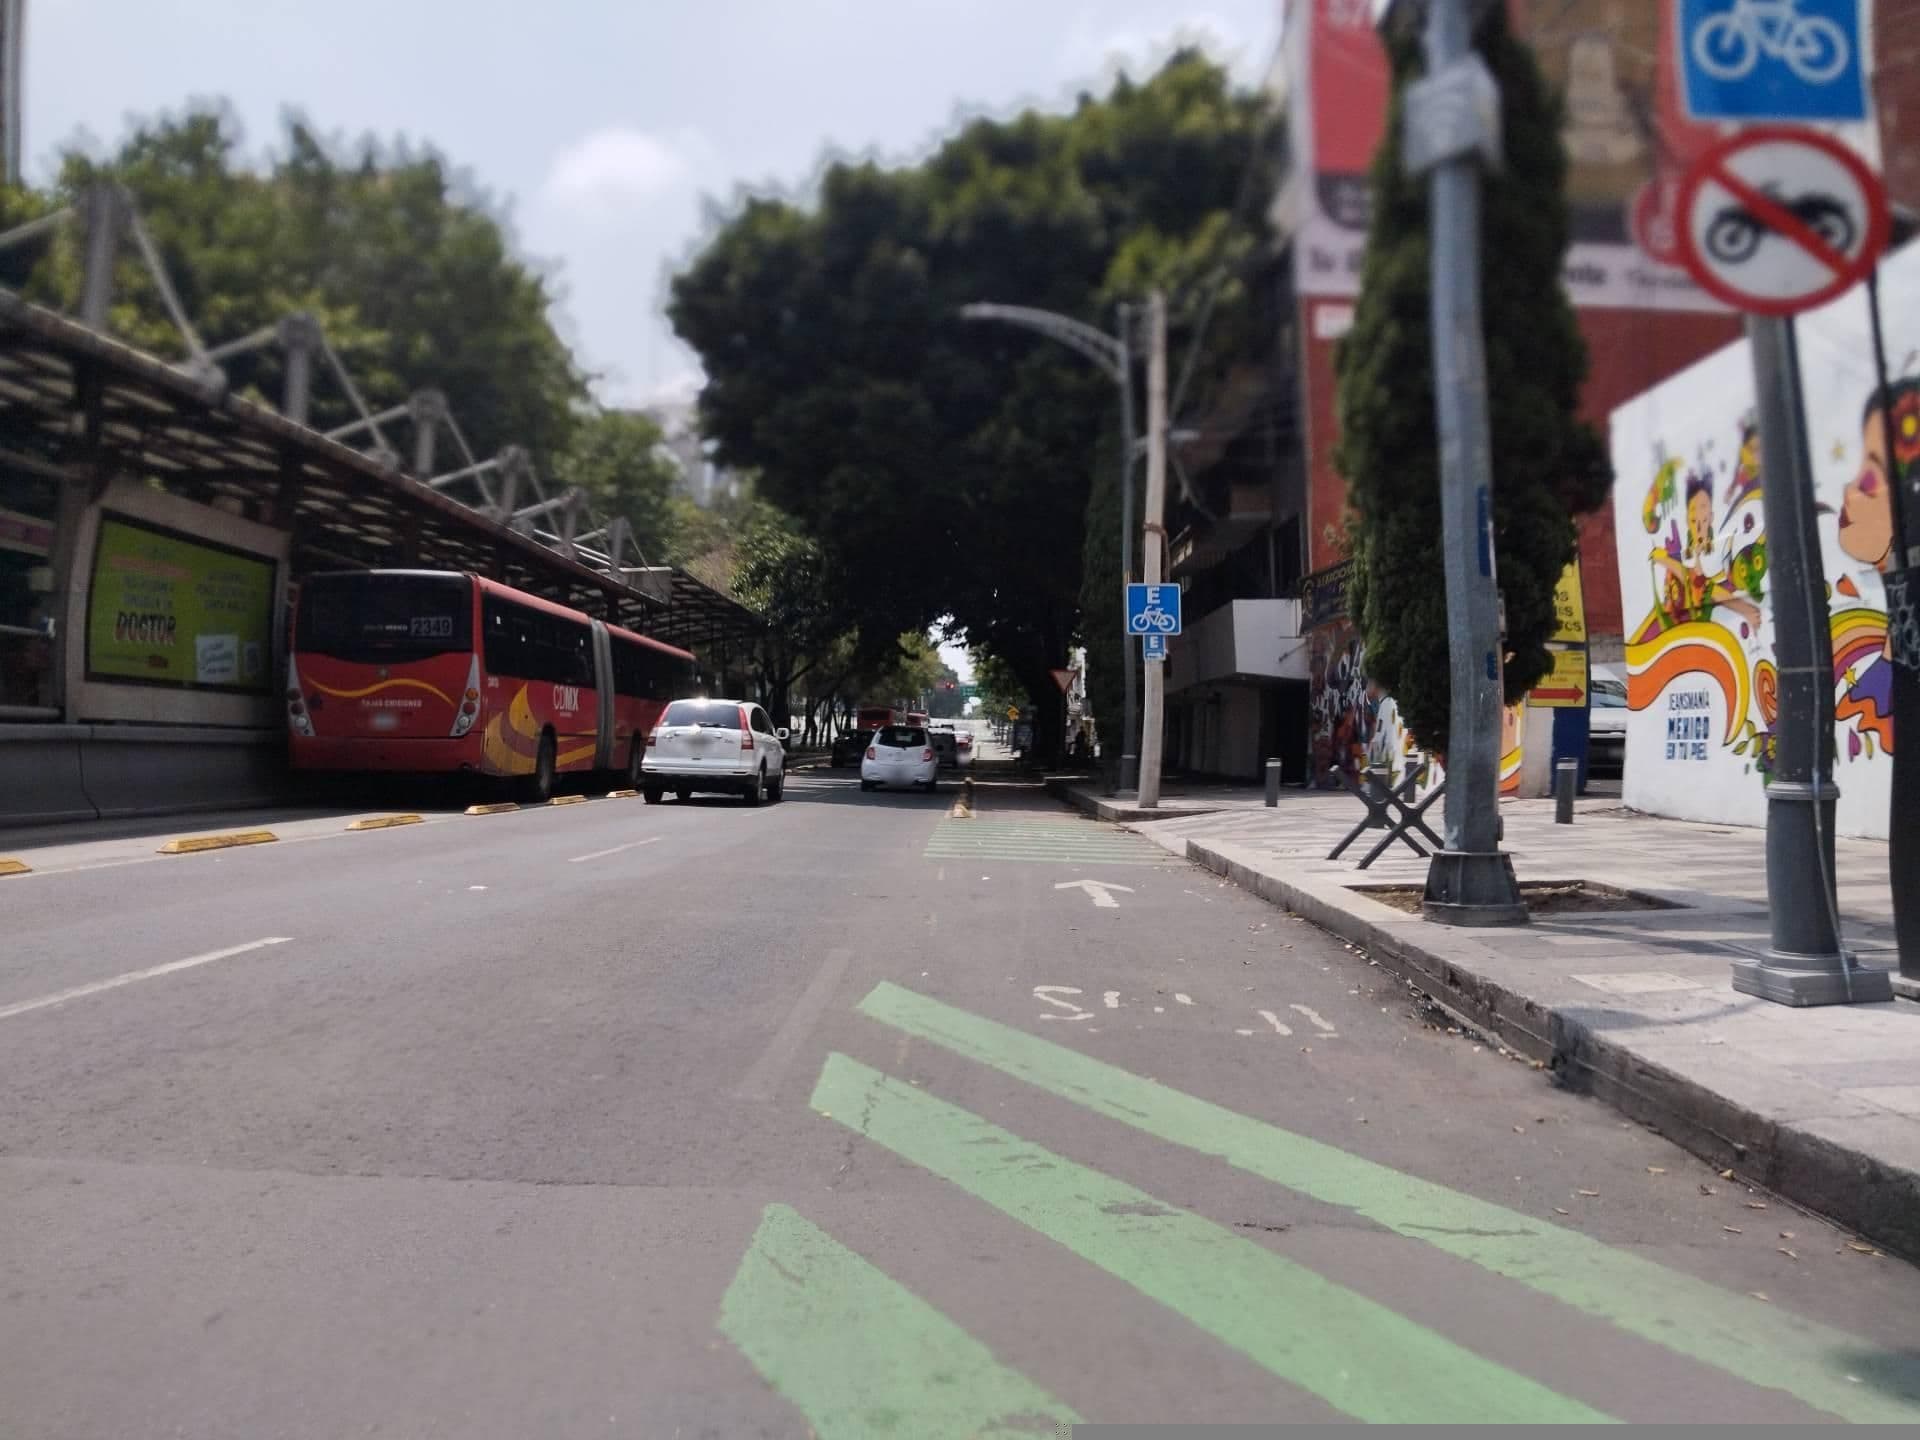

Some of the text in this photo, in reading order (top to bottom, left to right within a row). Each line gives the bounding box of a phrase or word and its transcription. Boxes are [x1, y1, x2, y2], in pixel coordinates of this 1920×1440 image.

[1147, 586, 1160, 604] E
[1150, 636, 1159, 648] E
[553, 685, 579, 711] CDMX
[1665, 742, 1676, 760] EN
[1679, 742, 1688, 760] TU
